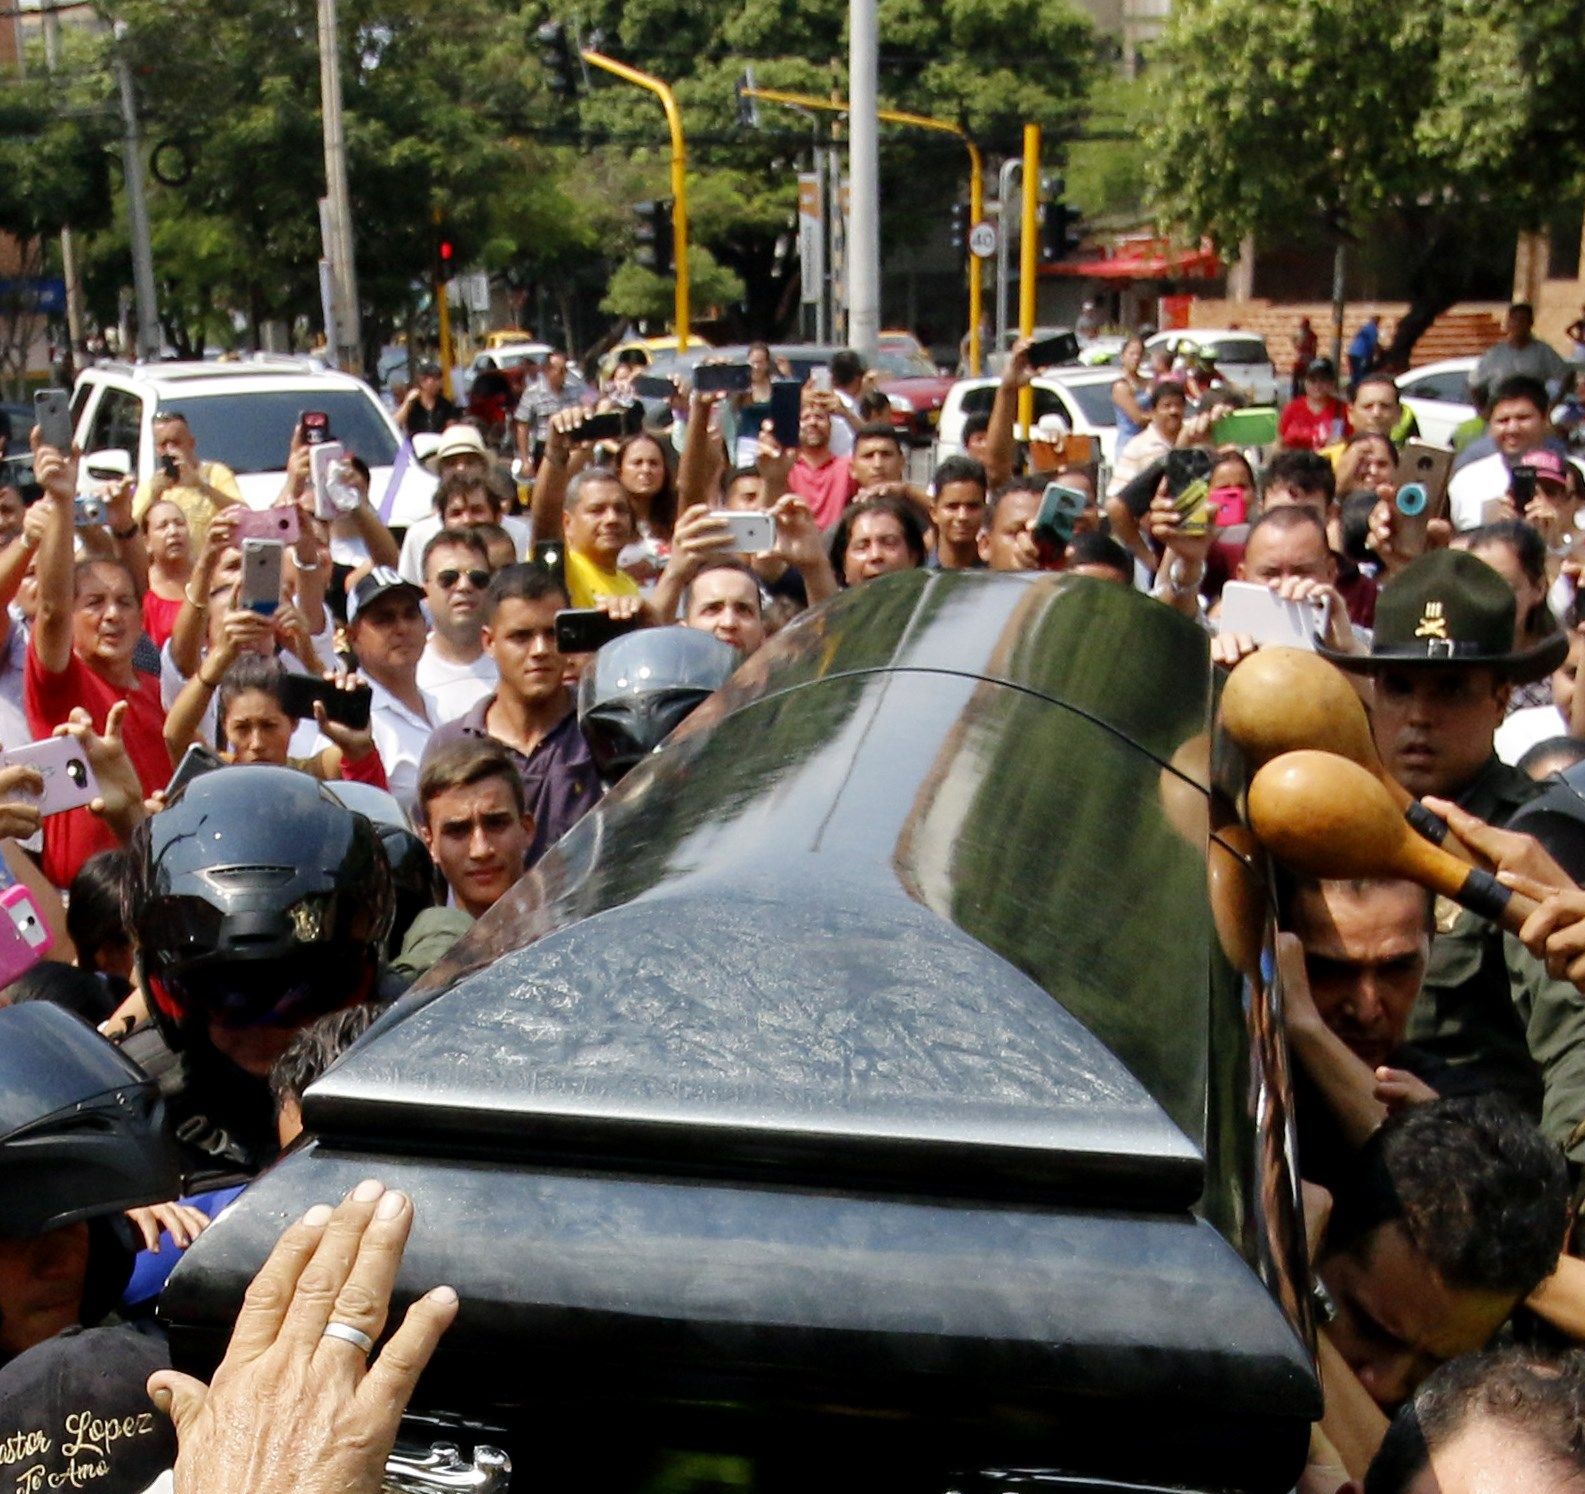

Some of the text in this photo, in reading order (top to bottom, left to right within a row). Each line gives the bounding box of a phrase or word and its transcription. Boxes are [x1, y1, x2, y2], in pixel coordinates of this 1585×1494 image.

[972, 232, 993, 247] 40
[371, 565, 403, 586] 10
[61, 1410, 154, 1457] Lopez
[47, 1458, 110, 1488] Amo
